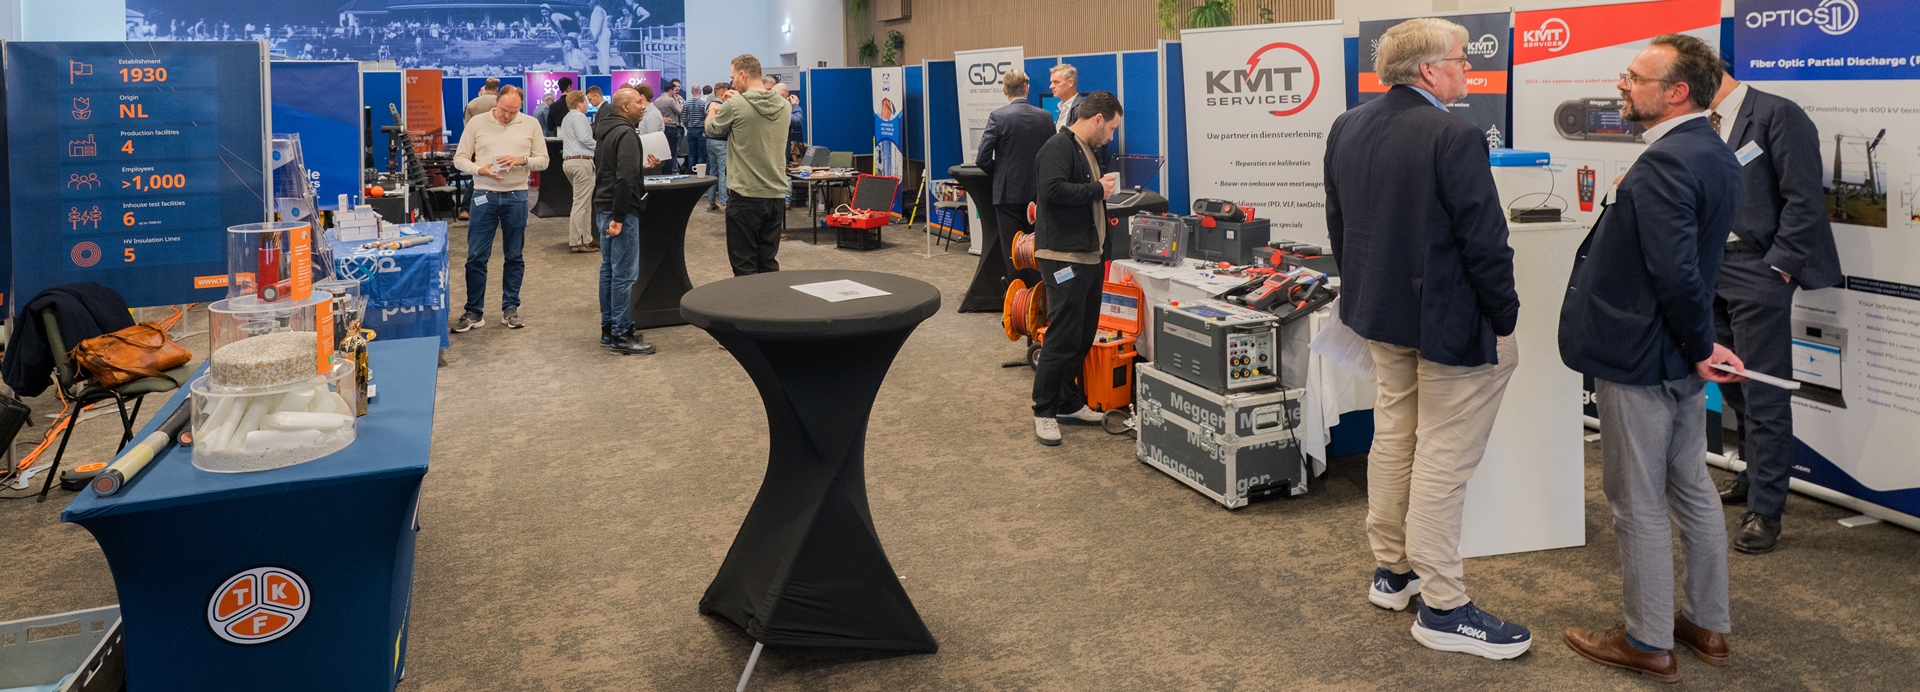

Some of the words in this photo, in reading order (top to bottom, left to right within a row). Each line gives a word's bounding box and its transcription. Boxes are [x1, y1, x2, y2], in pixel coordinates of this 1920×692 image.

[1523, 28, 1563, 42] KMT
[1467, 41, 1494, 50] KMT
[1750, 60, 1776, 68] Fiber
[1778, 58, 1805, 69] Optic
[1807, 57, 1844, 67] Partial
[1847, 56, 1907, 67] Discharge
[119, 67, 168, 82] 1930
[1206, 67, 1302, 95] KMT
[1206, 94, 1302, 106] SERVICES
[119, 103, 149, 118] NL
[1816, 105, 1858, 114] monitoring
[1206, 132, 1220, 140] Uw
[1221, 132, 1250, 140] partner
[1251, 131, 1259, 139] in
[1259, 130, 1324, 139] dienstverlening:
[121, 139, 134, 154] 4
[122, 173, 186, 192] >1,000
[1267, 201, 1282, 209] (PD,
[122, 211, 136, 227] 6
[123, 247, 136, 263] 5
[1858, 299, 1874, 307] Your
[1875, 303, 1920, 315] advantages
[1866, 324, 1881, 332] Wide
[1882, 328, 1908, 336] Dynamic
[1457, 624, 1487, 640] HOKA
